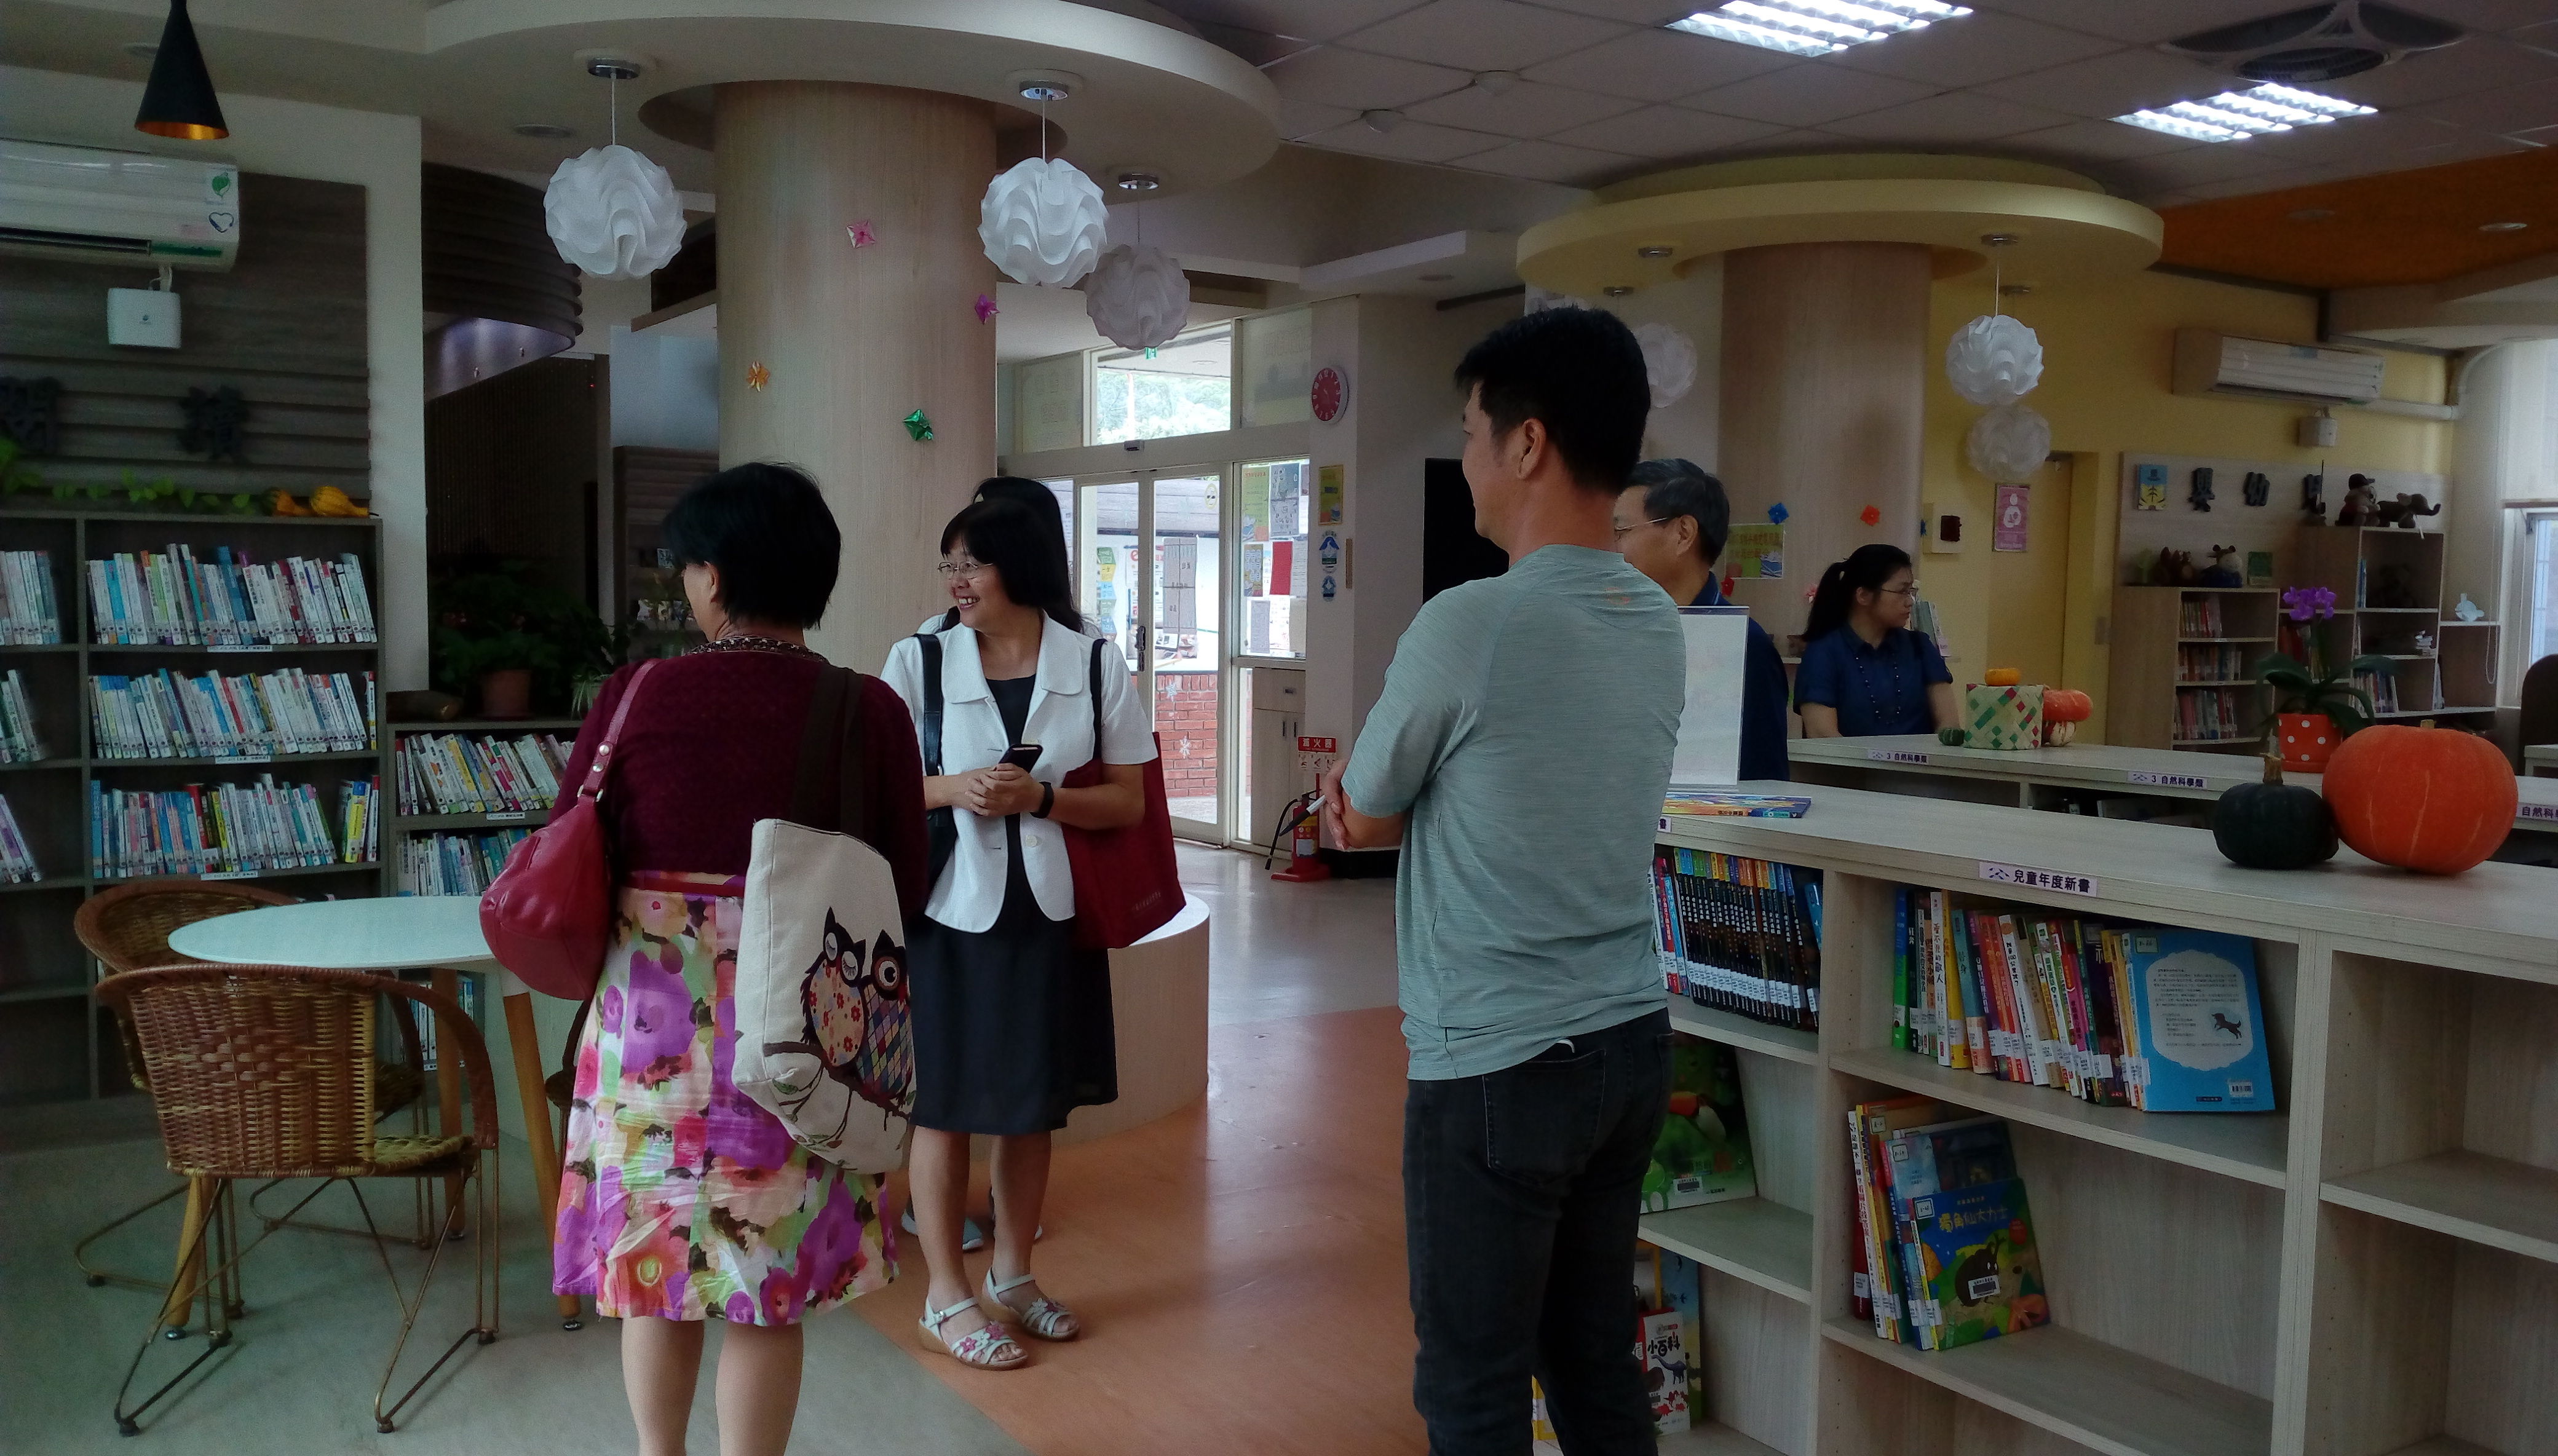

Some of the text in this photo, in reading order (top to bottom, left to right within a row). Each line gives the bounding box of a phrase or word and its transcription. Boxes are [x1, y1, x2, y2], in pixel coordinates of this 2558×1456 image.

[1302, 738, 1332, 748] 滅火器
[1894, 753, 1927, 763] 自然科學類
[2161, 775, 2204, 788] 自然科學類
[2013, 869, 2091, 893] 兒童年度新書
